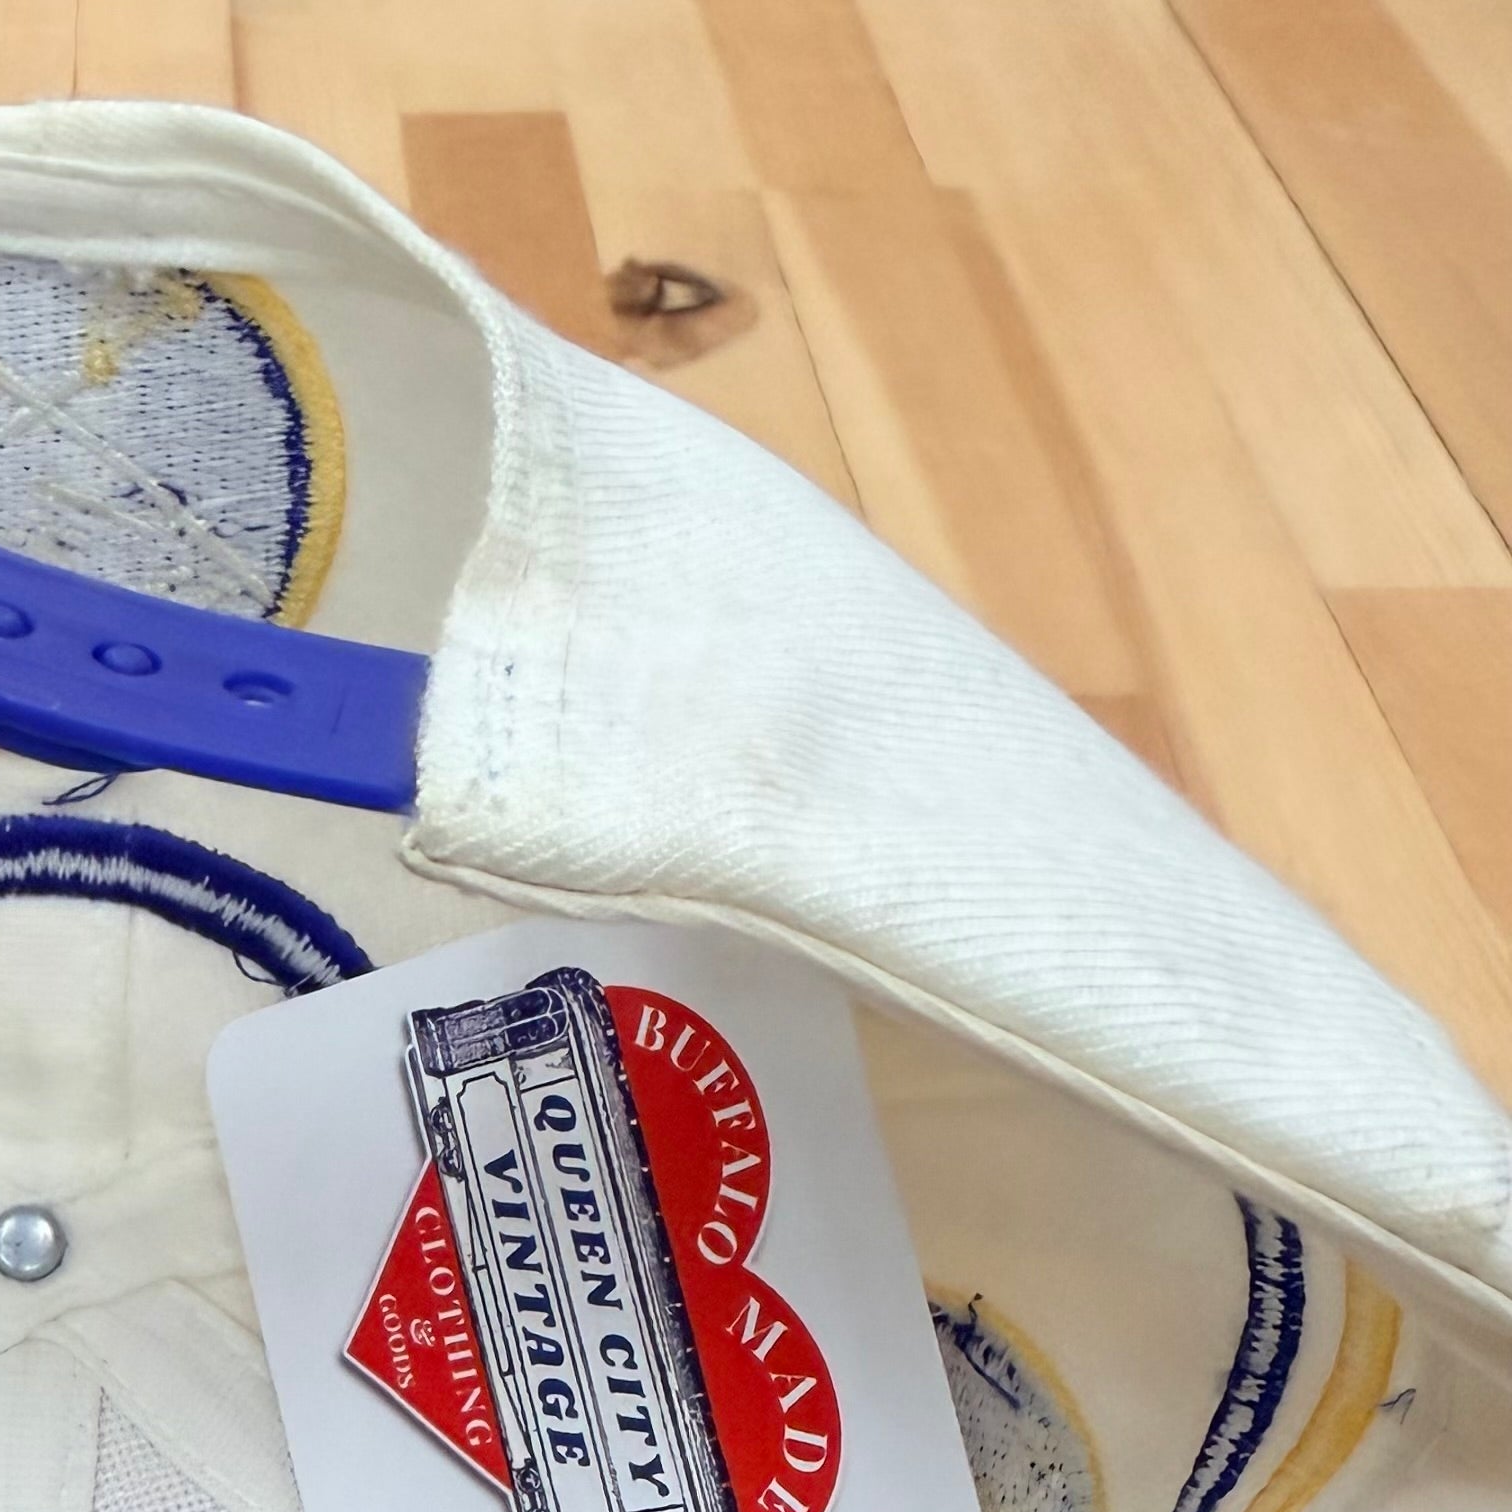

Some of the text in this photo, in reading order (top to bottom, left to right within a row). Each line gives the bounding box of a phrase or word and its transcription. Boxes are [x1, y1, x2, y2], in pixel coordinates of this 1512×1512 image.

[633, 1004, 762, 1265] BUFFALO
[378, 1293, 415, 1389] GOODS
[410, 1317, 436, 1348] &
[415, 1206, 493, 1447] CLOTHING
[484, 1150, 592, 1467] VINTAGE
[533, 1095, 671, 1499] QUEEN CITY
